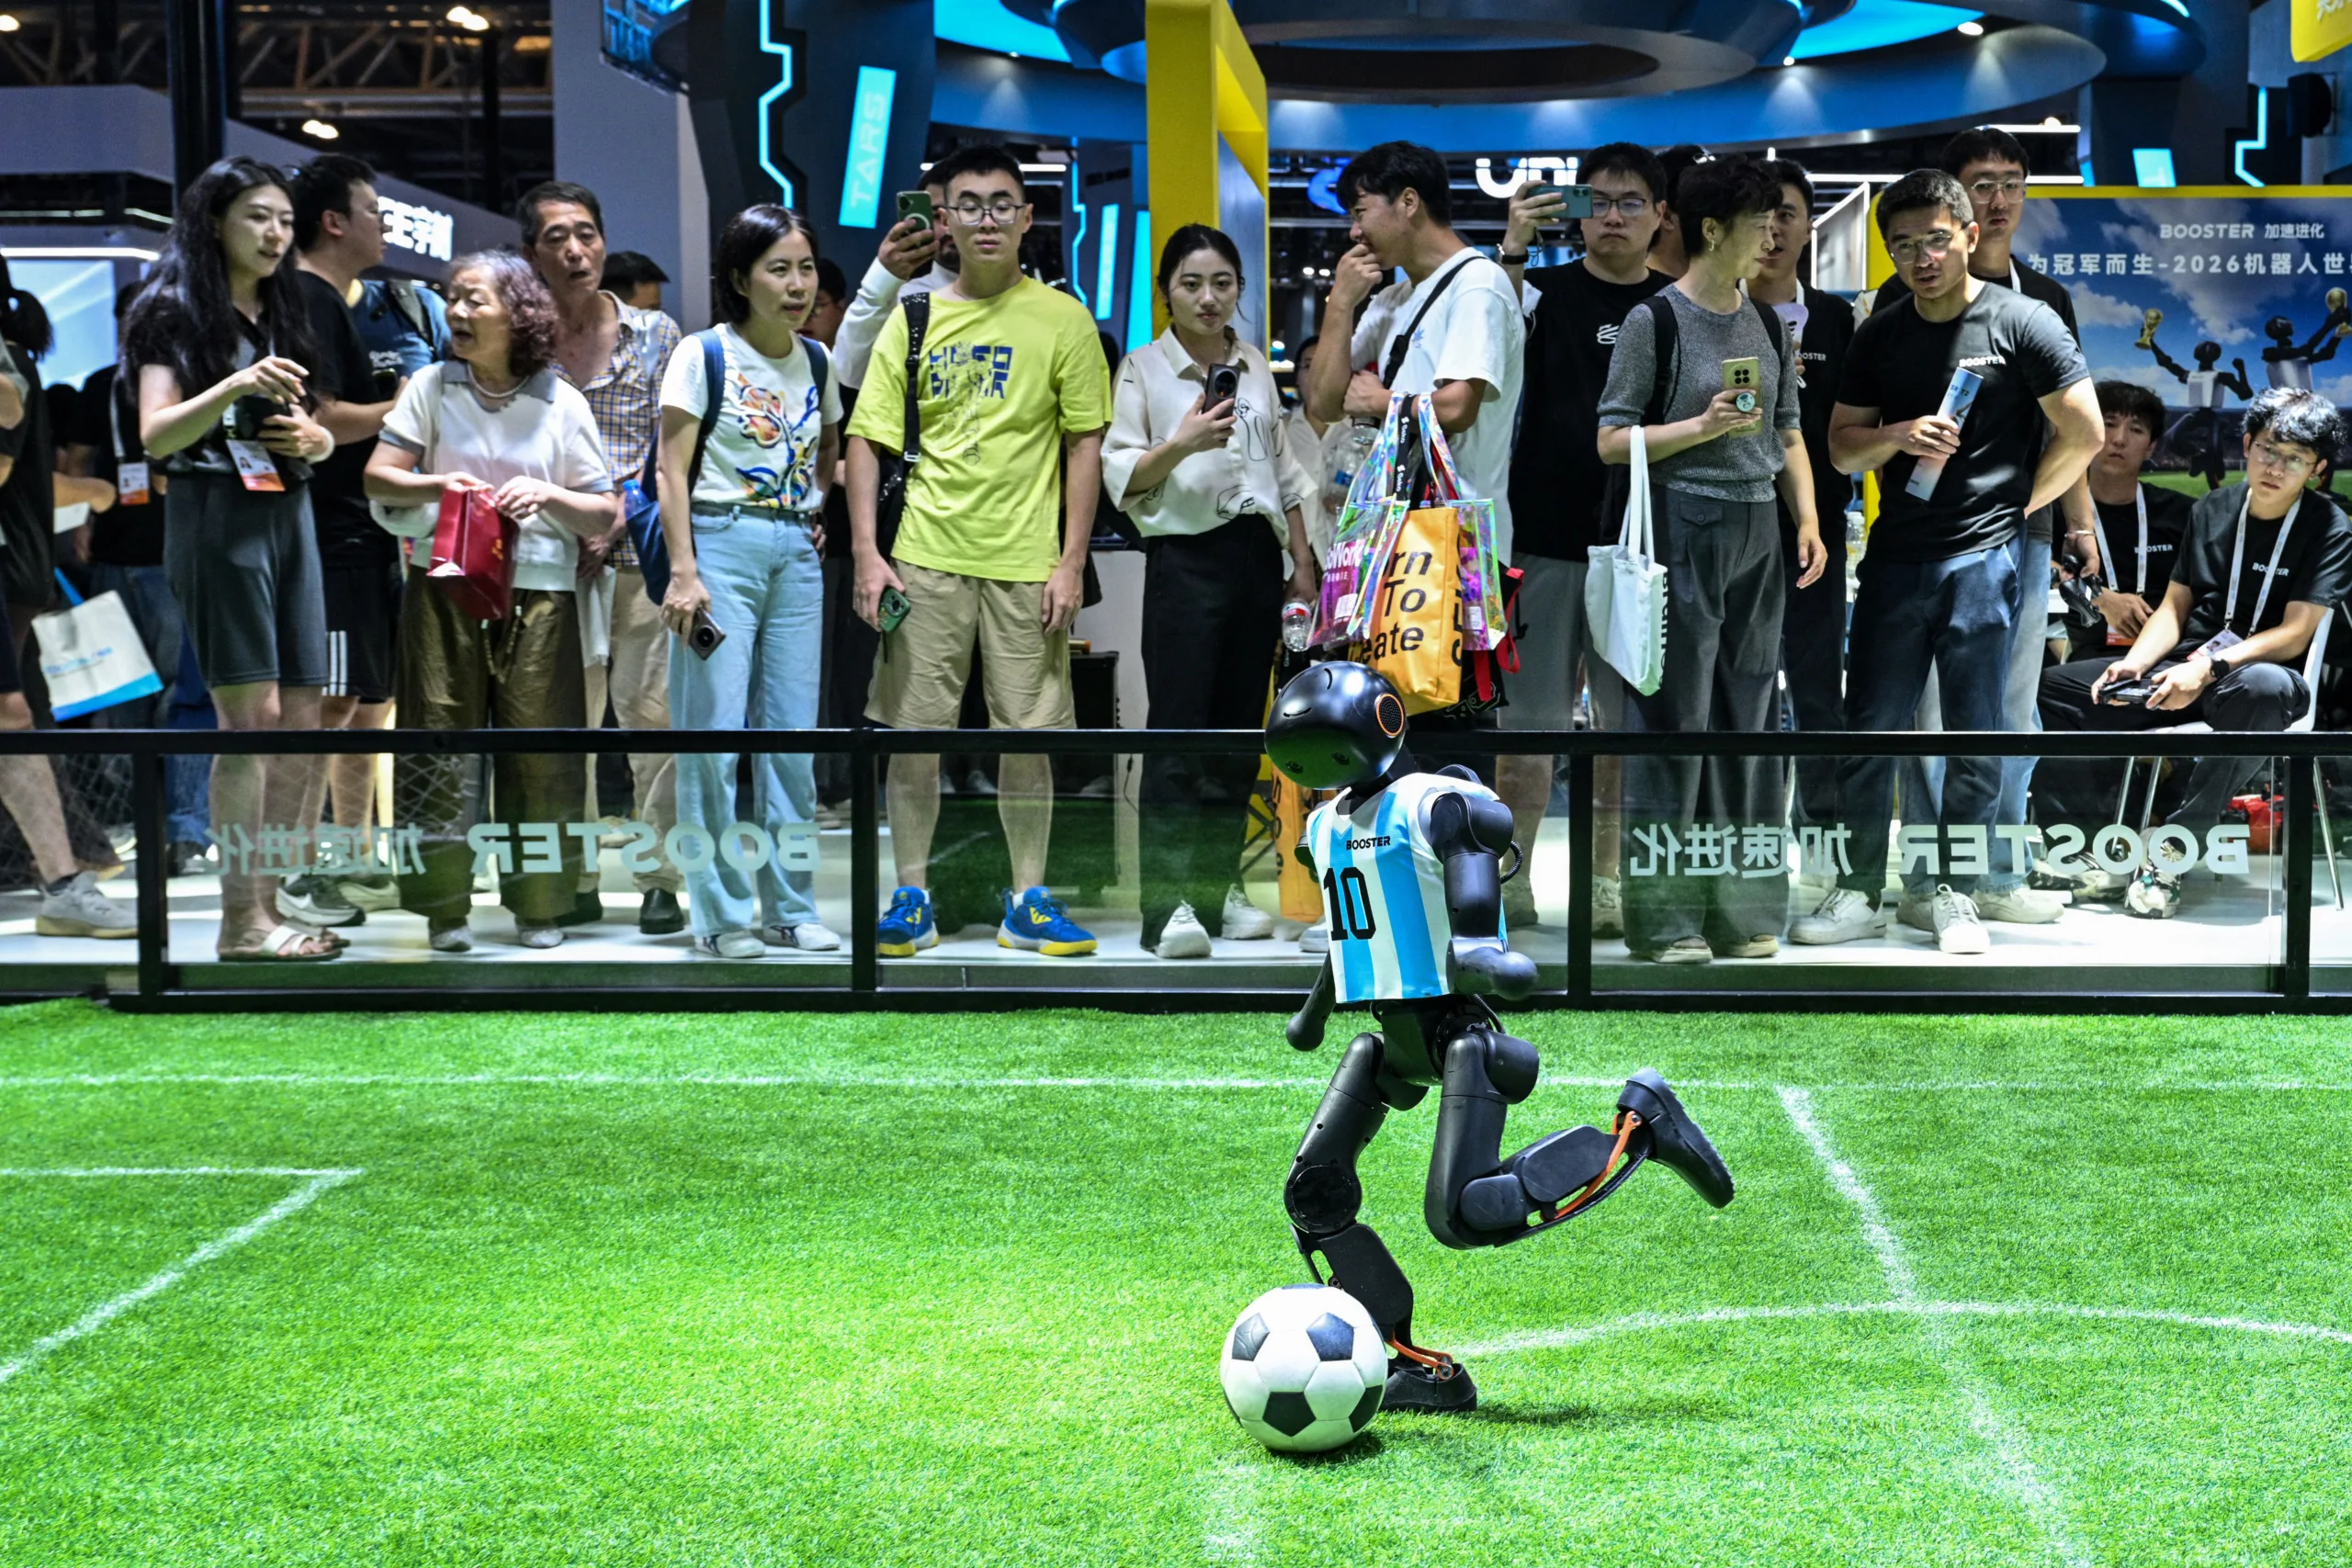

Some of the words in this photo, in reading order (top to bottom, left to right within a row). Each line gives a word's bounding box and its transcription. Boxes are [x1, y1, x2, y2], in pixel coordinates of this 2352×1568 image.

[849, 92, 888, 209] TARS
[2160, 223, 2255, 239] BOOSTER
[2264, 222, 2325, 240] 加速进化
[2027, 253, 2352, 276] 为冠军而生-2026机器人世
[1800, 352, 1827, 362] OSTER
[1958, 355, 2007, 367] BOOSTER
[2134, 544, 2174, 554] BOSTER
[1384, 579, 1427, 617] To
[1346, 836, 1391, 851] BOOSTER
[1323, 866, 1376, 942] 10
